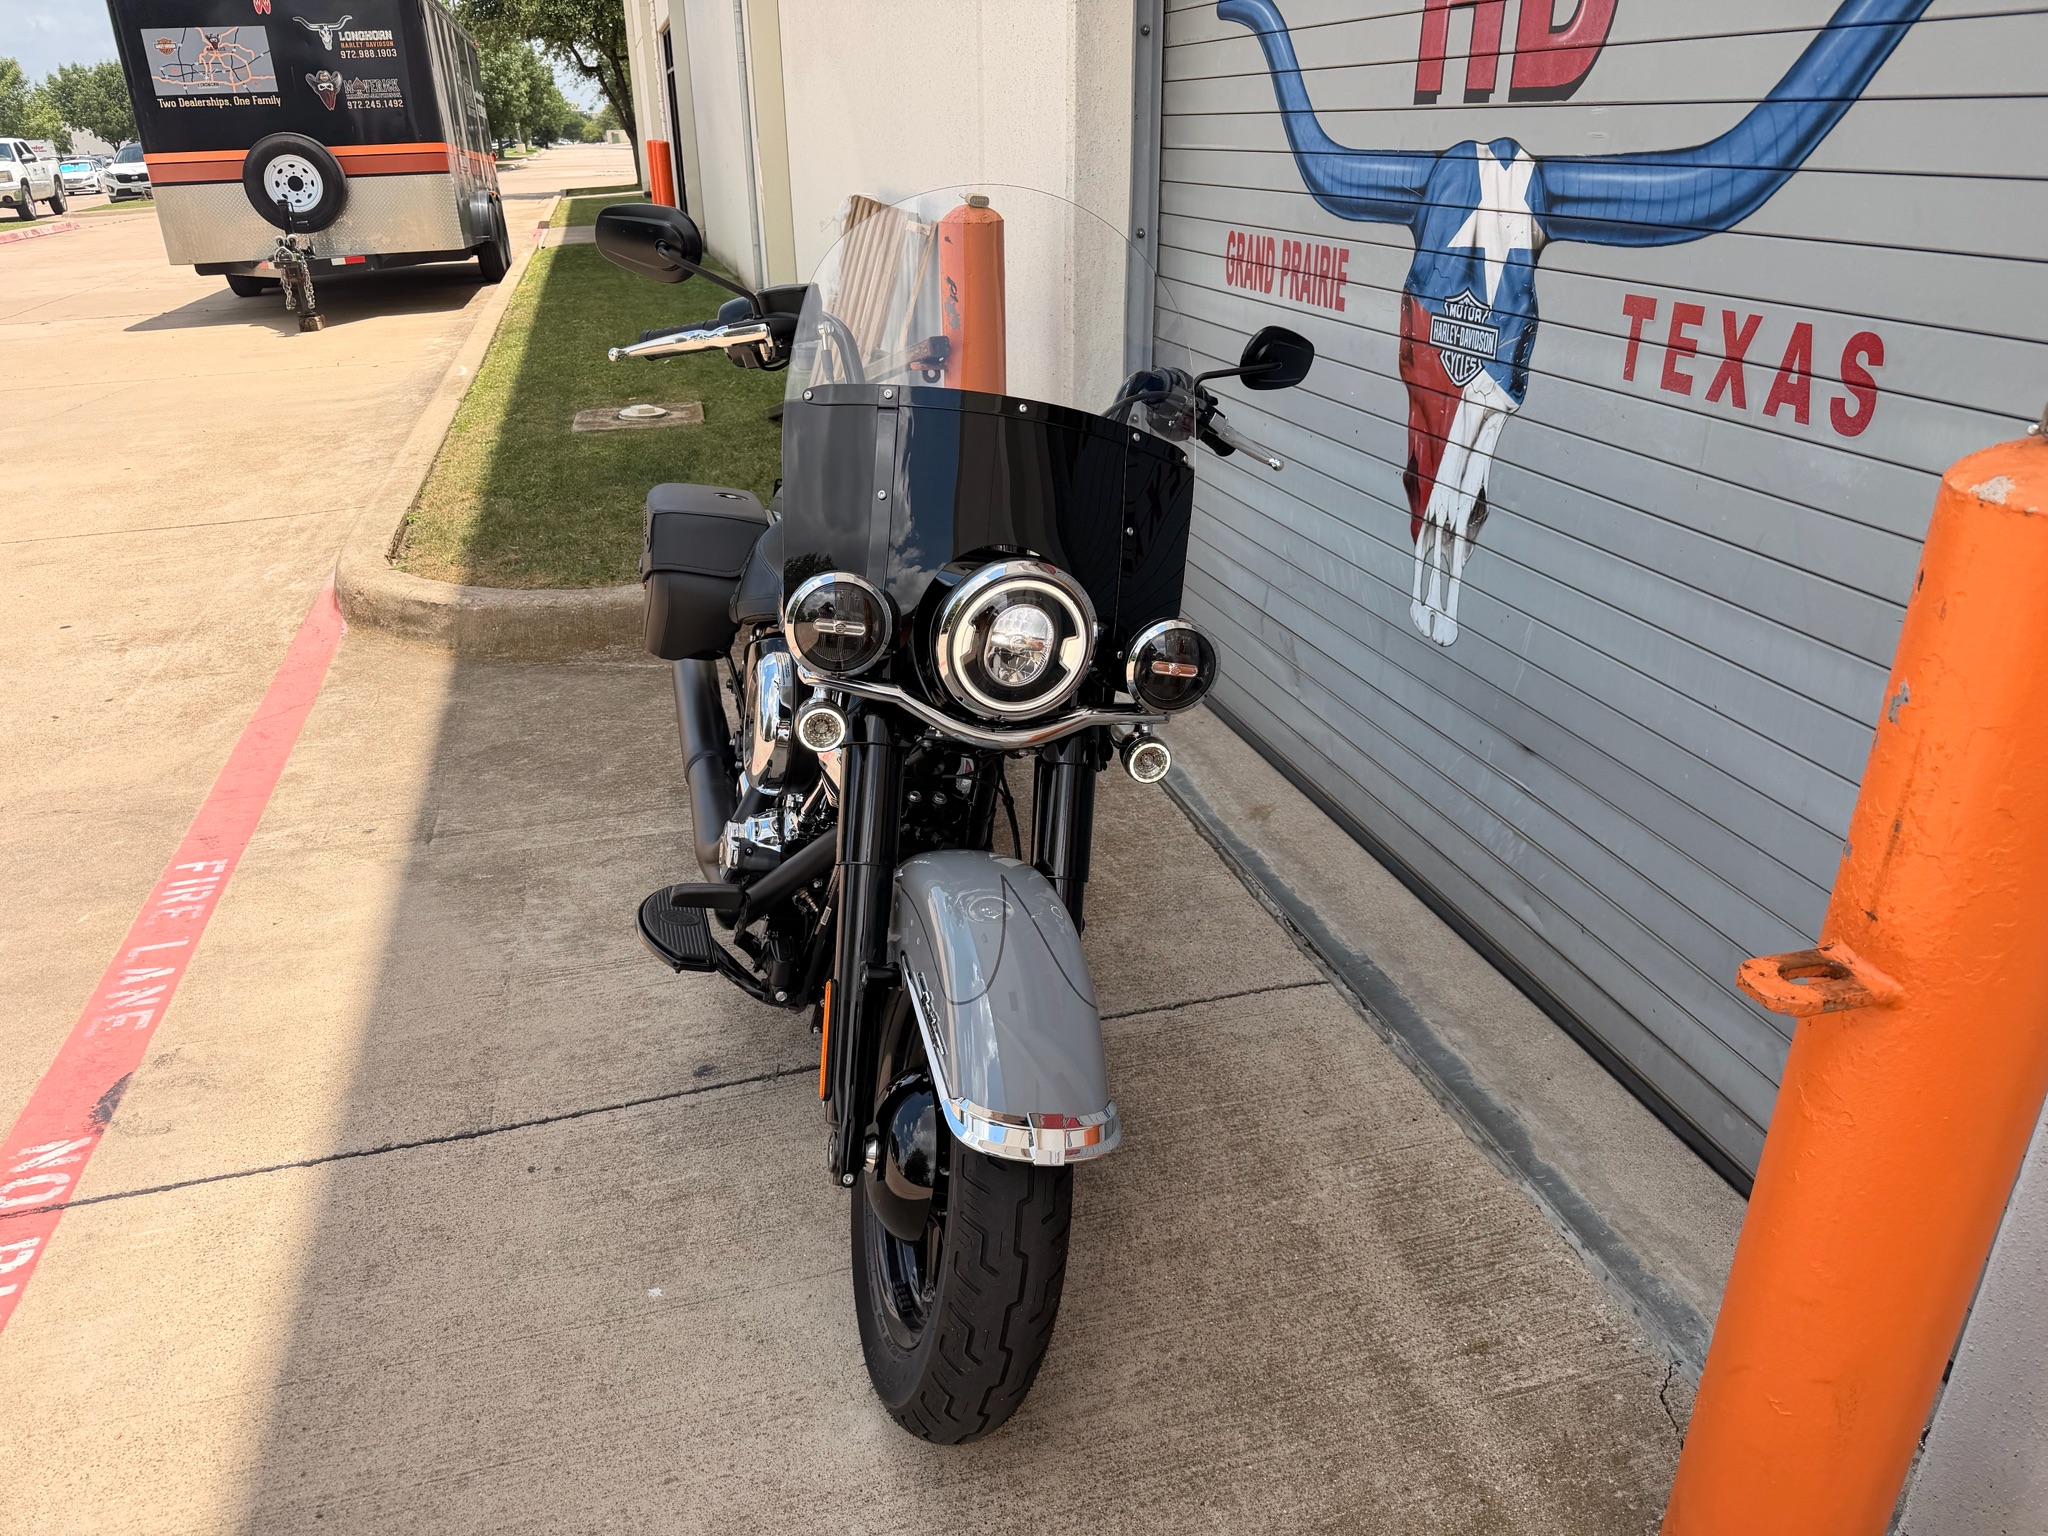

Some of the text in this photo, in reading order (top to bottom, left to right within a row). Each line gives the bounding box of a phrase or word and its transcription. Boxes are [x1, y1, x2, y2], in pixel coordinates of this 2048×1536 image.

[338, 30, 393, 42] LONGHORN
[340, 49, 397, 59] 972.988.1903
[157, 95, 281, 109] Two Dealerships, One Family
[347, 99, 404, 109] 972.245.1492
[1226, 229, 1350, 312] GRAND PRAIRIE
[1449, 305, 1482, 323] MOTOR
[1433, 321, 1494, 354] HARLEY-DAVIDSON
[1444, 350, 1477, 381] CYCLES
[1621, 293, 1885, 438] TEXAS
[84, 858, 229, 1037] FIRE LANE
[0, 1137, 93, 1209] NO
